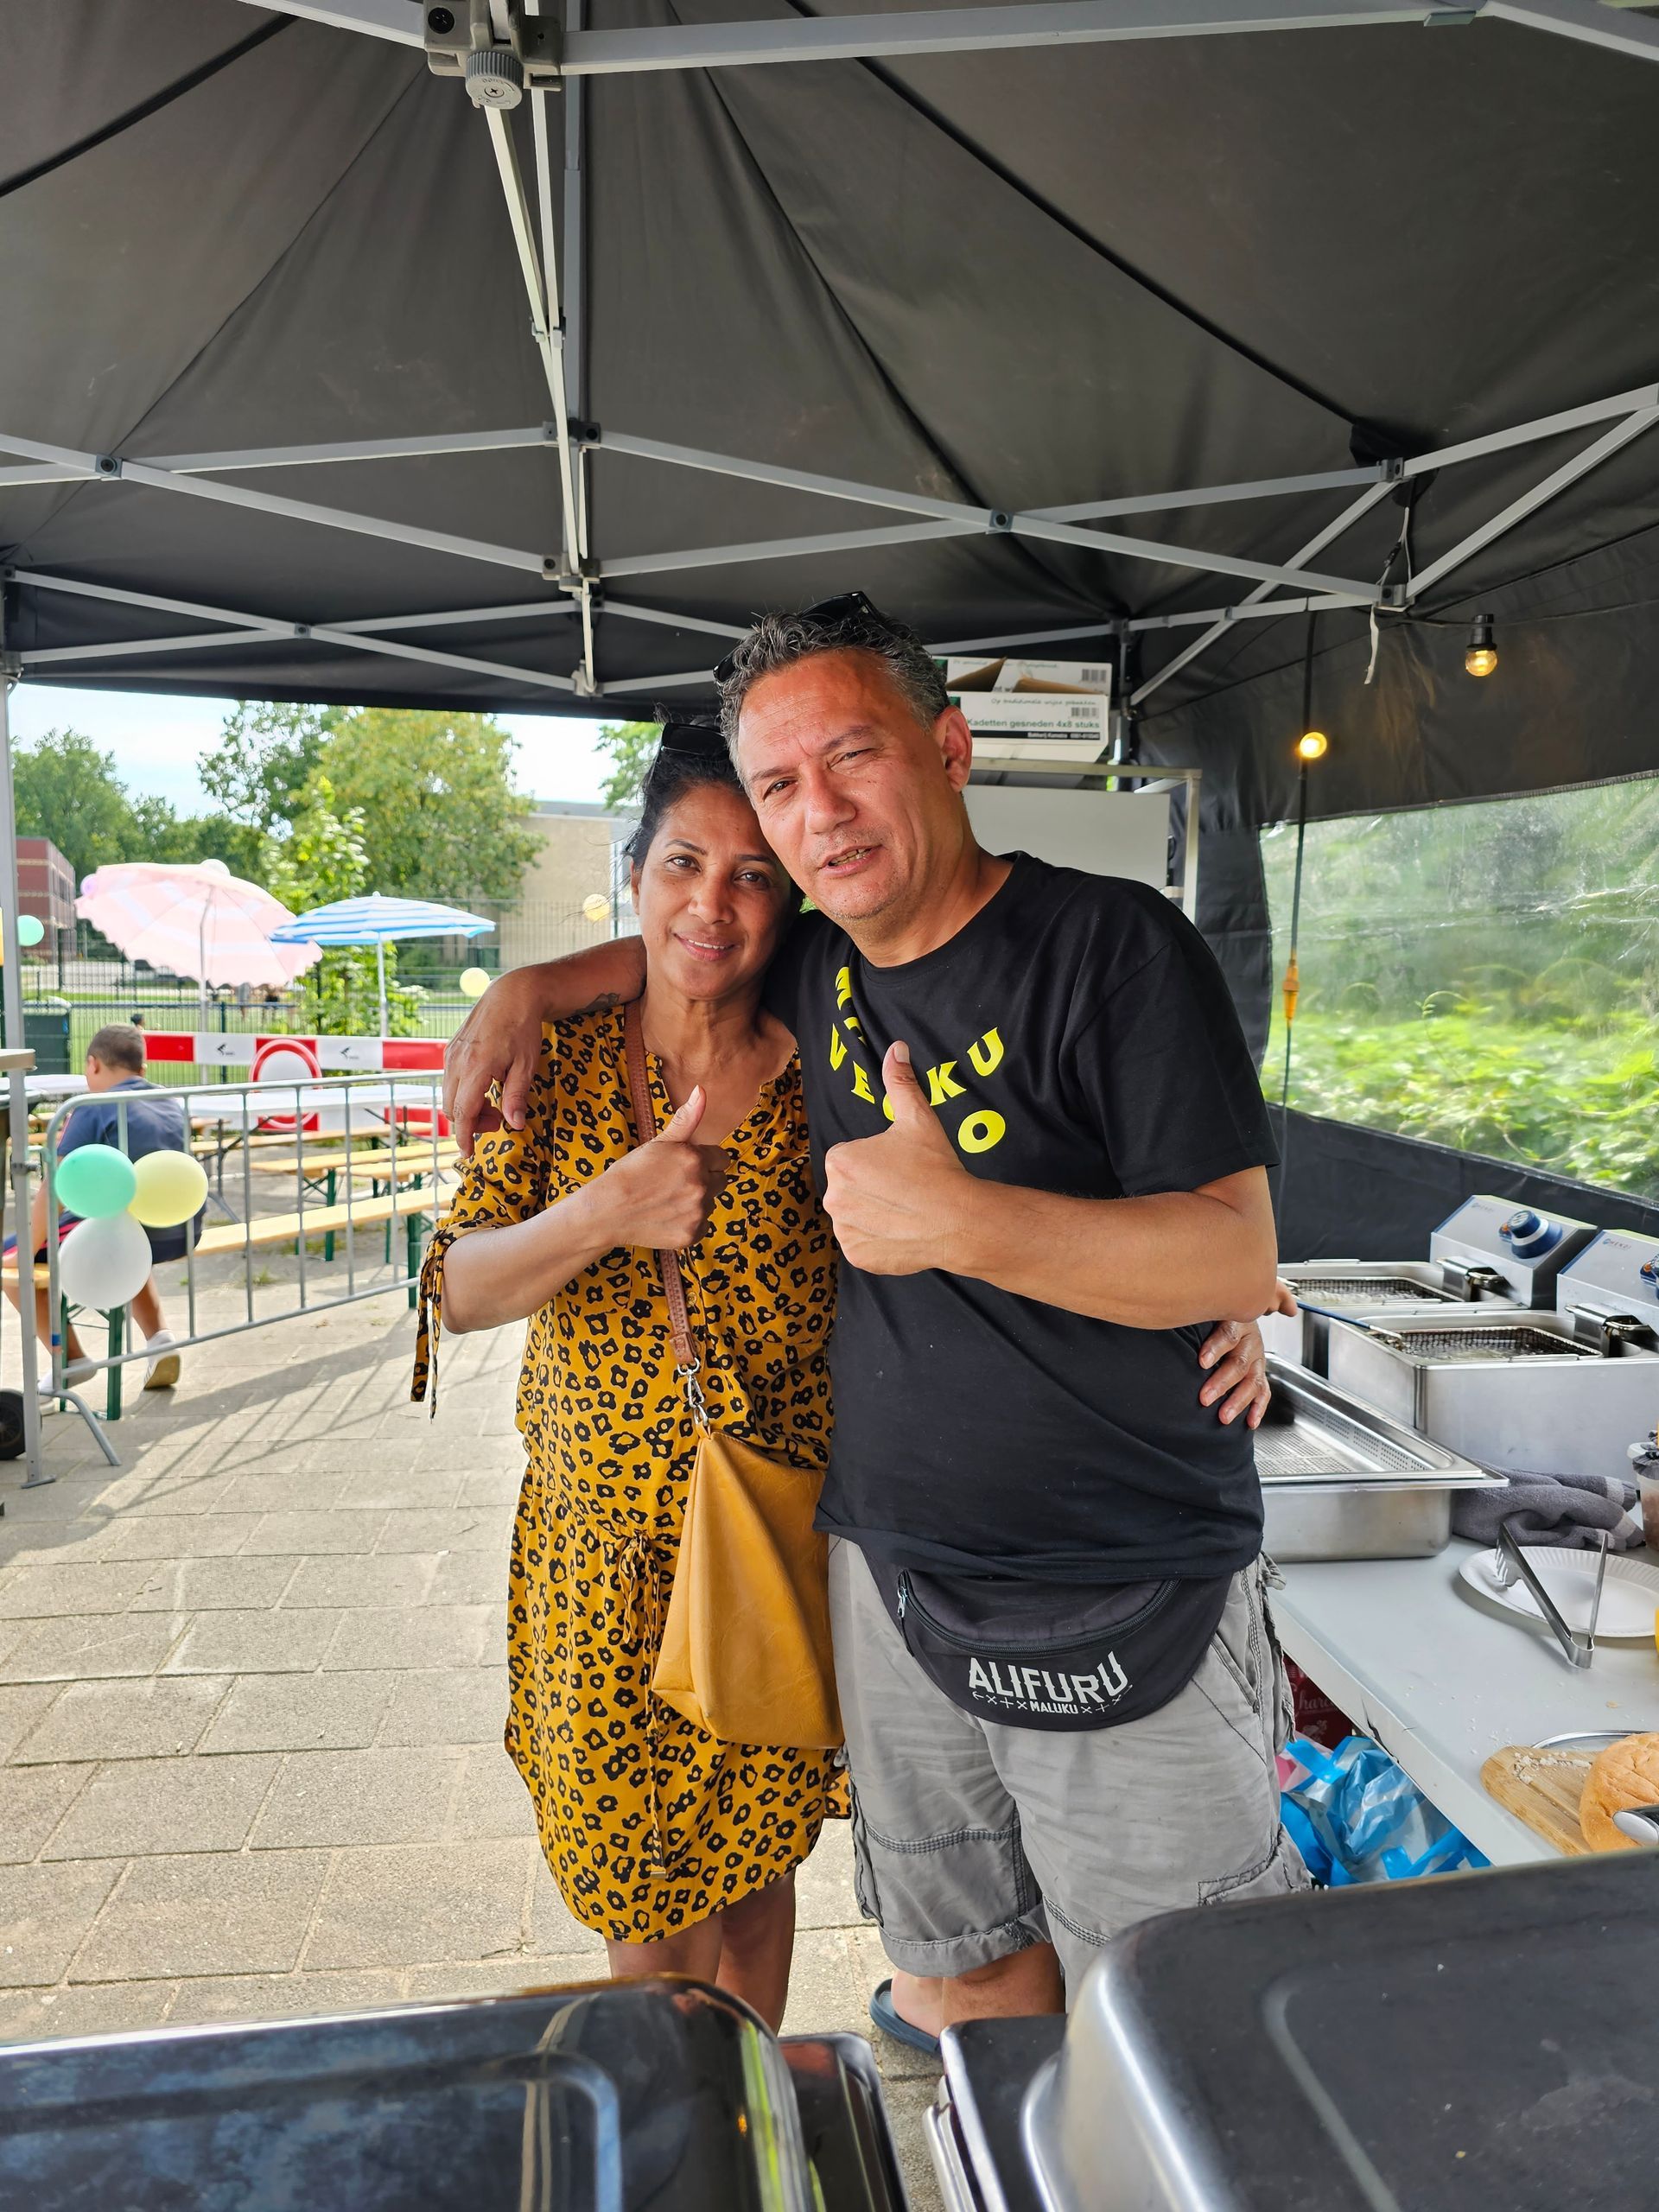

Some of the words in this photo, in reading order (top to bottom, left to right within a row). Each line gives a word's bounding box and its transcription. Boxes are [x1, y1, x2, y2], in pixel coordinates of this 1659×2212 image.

[1009, 719, 1054, 729] gesneden
[1074, 720, 1100, 729] stuks
[968, 1650, 1128, 1704] ALIFURU
[1029, 1700, 1079, 1714] MALUKU
